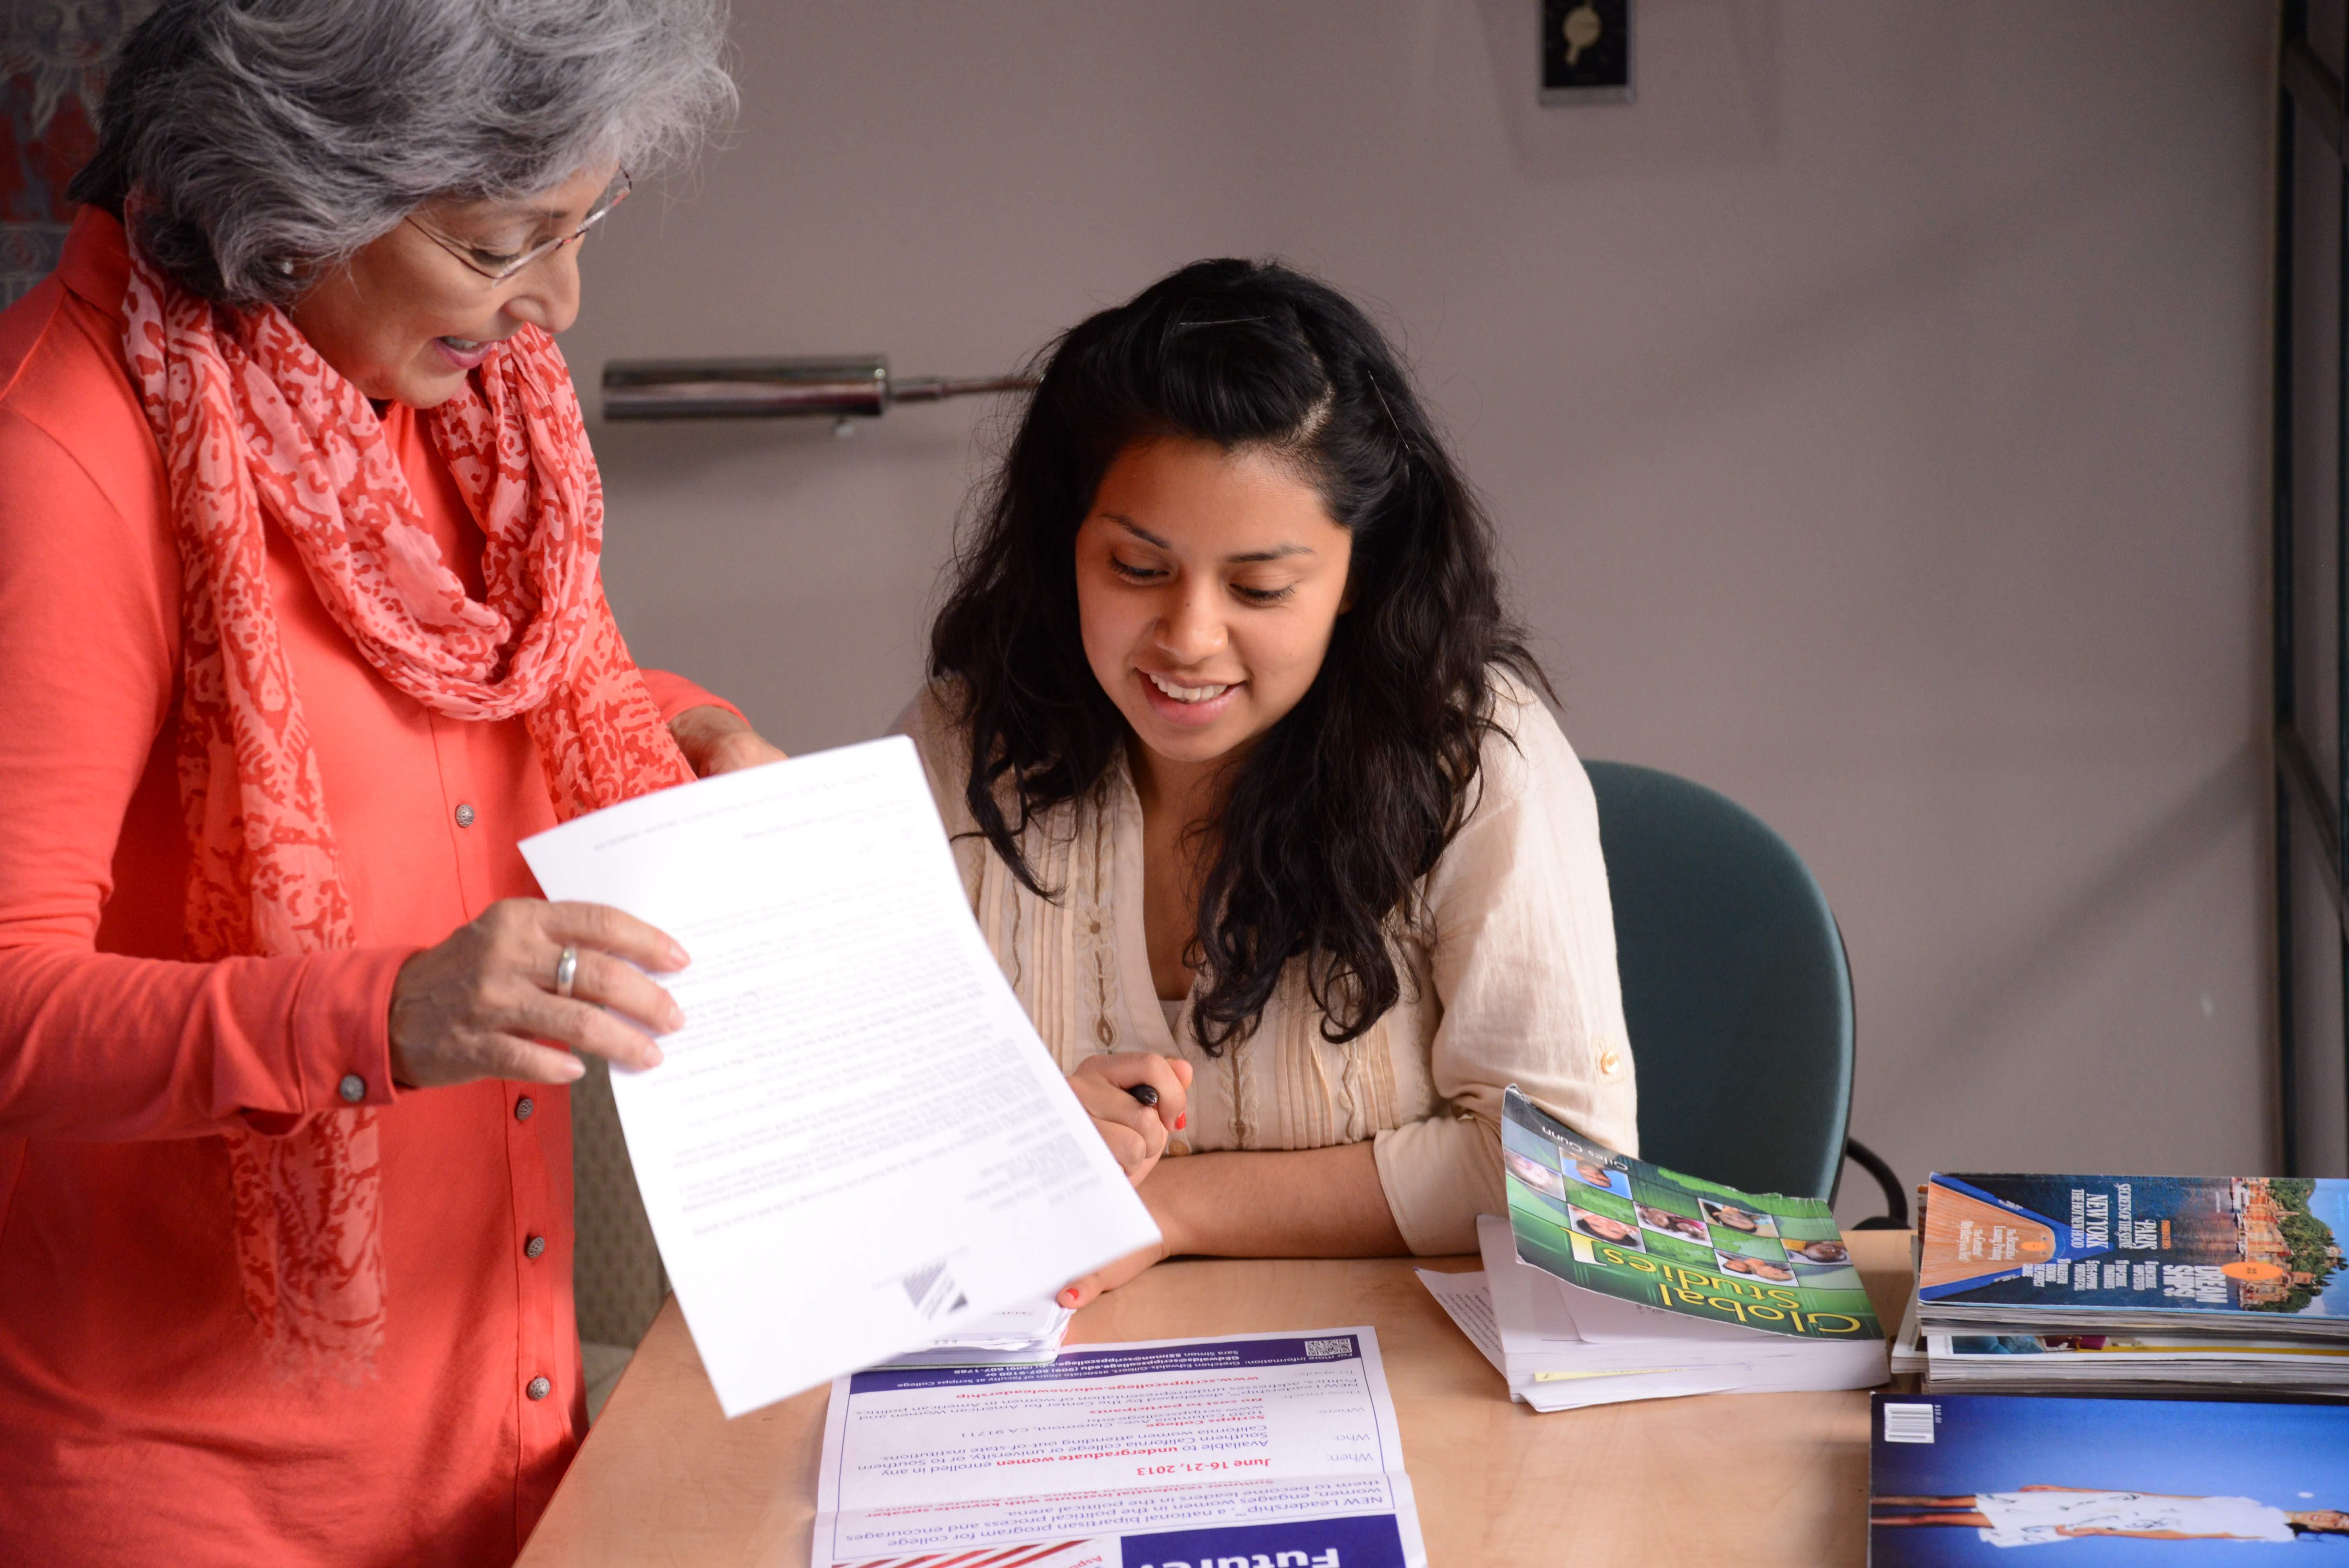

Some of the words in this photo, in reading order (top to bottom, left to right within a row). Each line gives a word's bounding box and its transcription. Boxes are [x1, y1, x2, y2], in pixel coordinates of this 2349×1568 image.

[1541, 1126, 1584, 1153] Gunn
[1587, 1148, 1628, 1172] Giles
[2071, 1188, 2084, 1202] THE
[2114, 1183, 2132, 1211] SECRETS
[2071, 1201, 2084, 1216] HOT
[2086, 1193, 2108, 1220] NEW
[2119, 1211, 2132, 1220] OF
[2071, 1215, 2084, 1229] NEW
[2118, 1220, 2132, 1233] THE
[2071, 1229, 2084, 1249] HOOD
[2086, 1219, 2108, 1249] YORK
[2131, 1219, 2158, 1249] PARIS
[2115, 1231, 2133, 1249] SEINE
[1602, 1248, 1800, 1310] Studies
[2162, 1265, 2196, 1297] SHIPS!
[2196, 1265, 2228, 1303] DREAM
[1658, 1283, 1861, 1333] Global
[956, 1377, 1259, 1399] www.scrippscollege.edu/newleadership
[1078, 1388, 1226, 1401] underrepresentation
[1148, 1393, 1223, 1402] developed
[1089, 1403, 1182, 1414] participants
[1155, 1414, 1224, 1422] Columbia
[1198, 1425, 1267, 1434] California
[1062, 1435, 1133, 1445] attending
[1200, 1432, 1267, 1441] Southern
[1333, 1434, 1370, 1442] Who:
[971, 1441, 1057, 1452] out-of-state
[1126, 1438, 1195, 1447] California
[1202, 1440, 1268, 1450] Available
[879, 1449, 965, 1460] institutions.
[1059, 1447, 1178, 1460] undergraduate
[1327, 1453, 1373, 1462] When:
[858, 1460, 926, 1470] Southern
[997, 1457, 1054, 1466] women
[1180, 1461, 1228, 1472] 16-21,
[1234, 1459, 1271, 1467] June
[931, 1462, 991, 1473] enrolled
[1137, 1465, 1175, 1475] 2013
[1210, 1480, 1274, 1488] Summer
[1118, 1486, 1202, 1497] residential
[1180, 1492, 1237, 1500] leaders
[1244, 1486, 1309, 1495] become
[1315, 1488, 1380, 1497] women,
[1045, 1493, 1112, 1502] institute
[1240, 1493, 1309, 1503] engages
[1344, 1496, 1382, 1506] NEW
[935, 1503, 1000, 1511] keynote
[1060, 1501, 1123, 1513] political
[1174, 1500, 1234, 1509] women
[984, 1515, 1045, 1527] process
[1052, 1509, 1116, 1522] political
[1146, 1510, 1212, 1523] national
[949, 1523, 978, 1532] and
[1058, 1516, 1139, 1529] bipartisan
[847, 1527, 943, 1541] encourages
[981, 1524, 1052, 1536] program
[889, 1536, 948, 1546] college
[1069, 1556, 1103, 1568] Aspi
[1140, 1548, 1340, 1568] Futur
